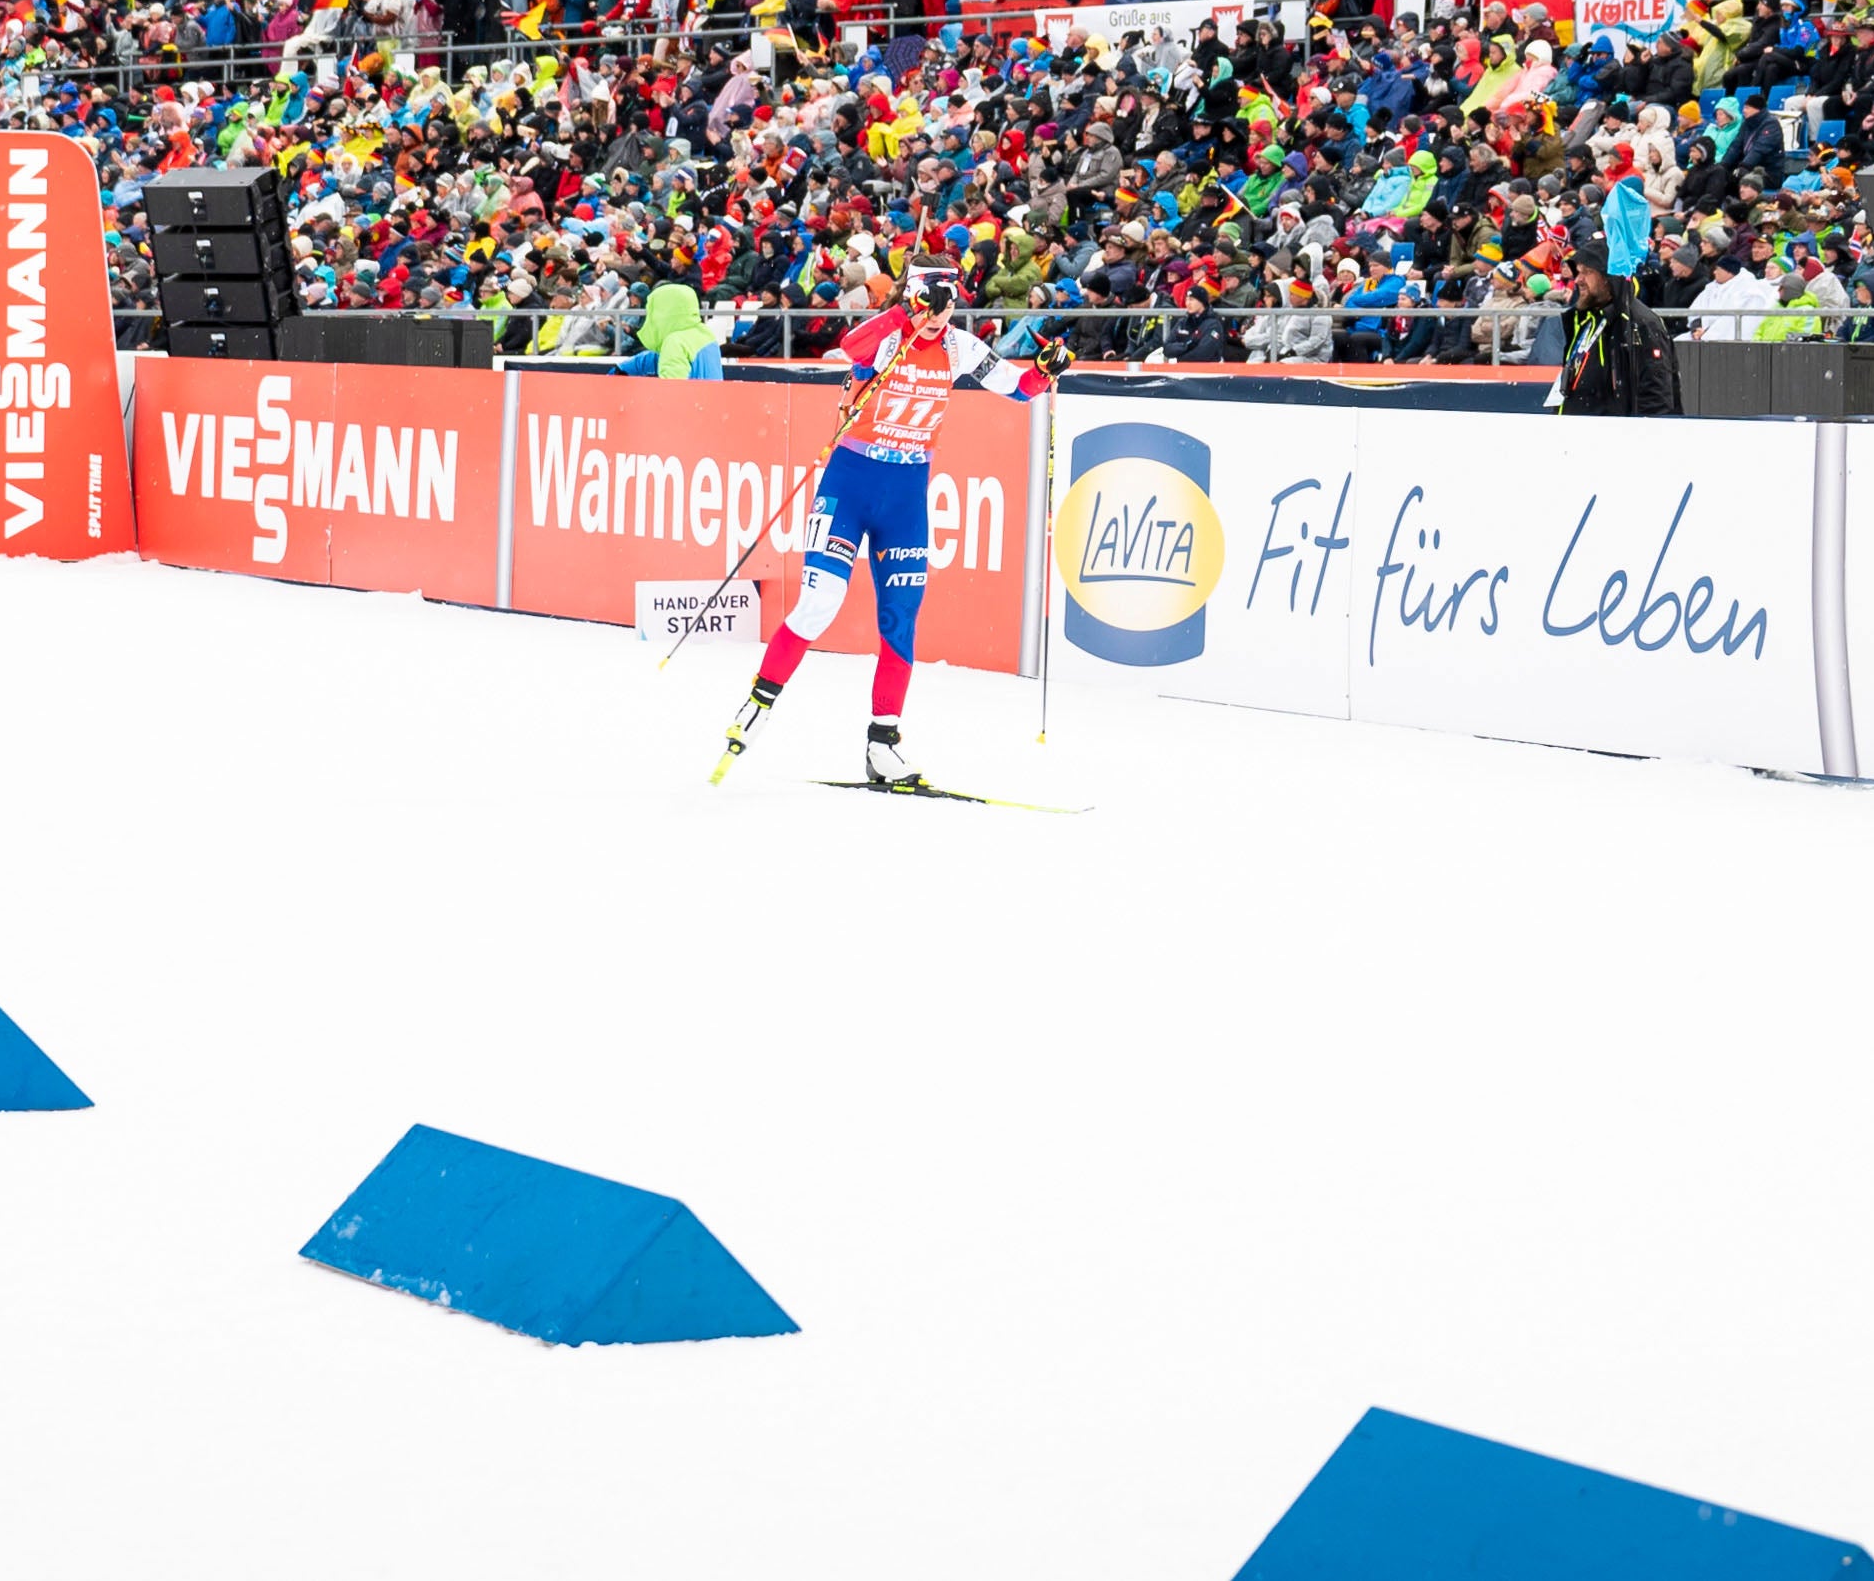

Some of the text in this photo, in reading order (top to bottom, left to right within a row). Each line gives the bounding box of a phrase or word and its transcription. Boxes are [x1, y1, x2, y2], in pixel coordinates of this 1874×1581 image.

[1109, 10, 1171, 28] Grüße aus
[889, 379, 914, 393] Heat
[162, 375, 458, 563] VIESSMANN
[527, 414, 1004, 577] Wärmepuen
[88, 453, 102, 539] SPLIT TIME
[1246, 471, 1352, 617] Fit
[1368, 486, 1509, 667] fürs
[1542, 481, 1769, 660] Leben
[653, 594, 750, 612] HAND-OVER
[667, 614, 737, 635] START
